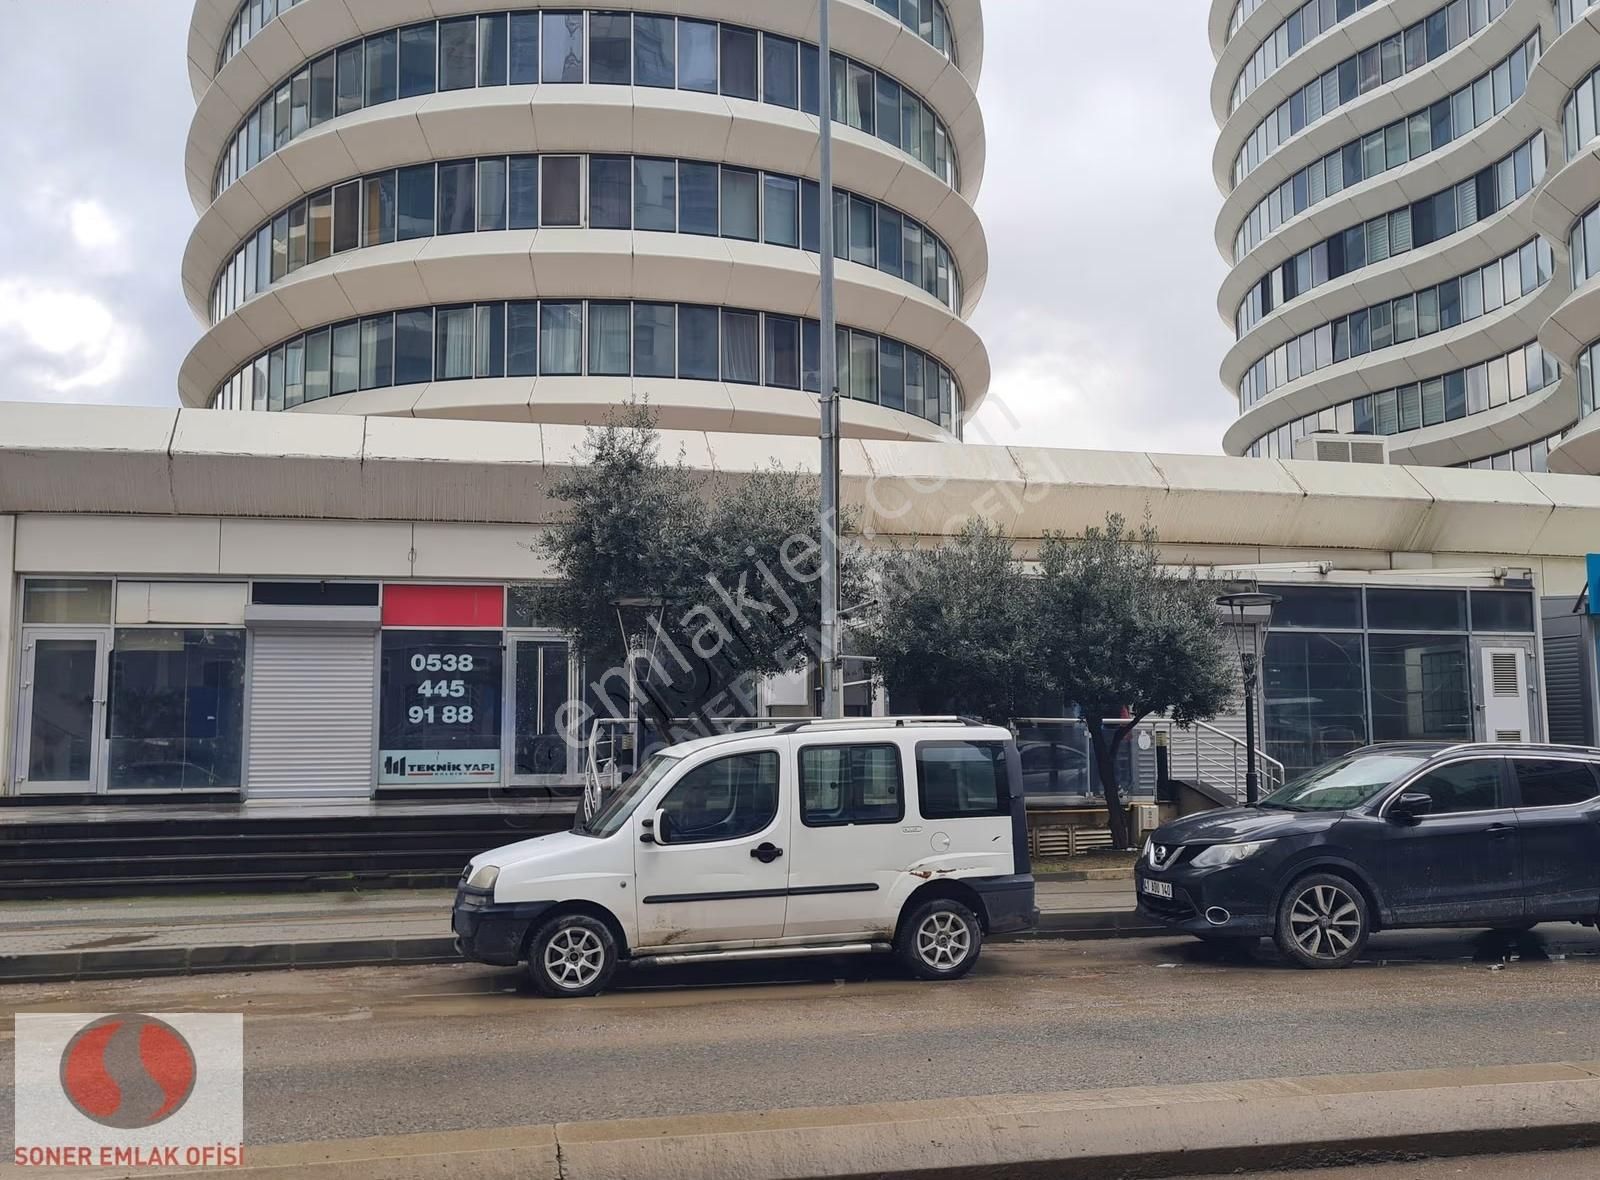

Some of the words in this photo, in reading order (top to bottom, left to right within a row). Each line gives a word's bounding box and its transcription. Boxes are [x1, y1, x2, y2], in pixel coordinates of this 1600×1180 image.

[410, 653, 474, 672] 0538
[417, 679, 465, 697] 445
[408, 705, 435, 723] 91
[441, 705, 474, 723] 88
[407, 762, 462, 772] TEKNİK
[463, 763, 495, 771] YAPI
